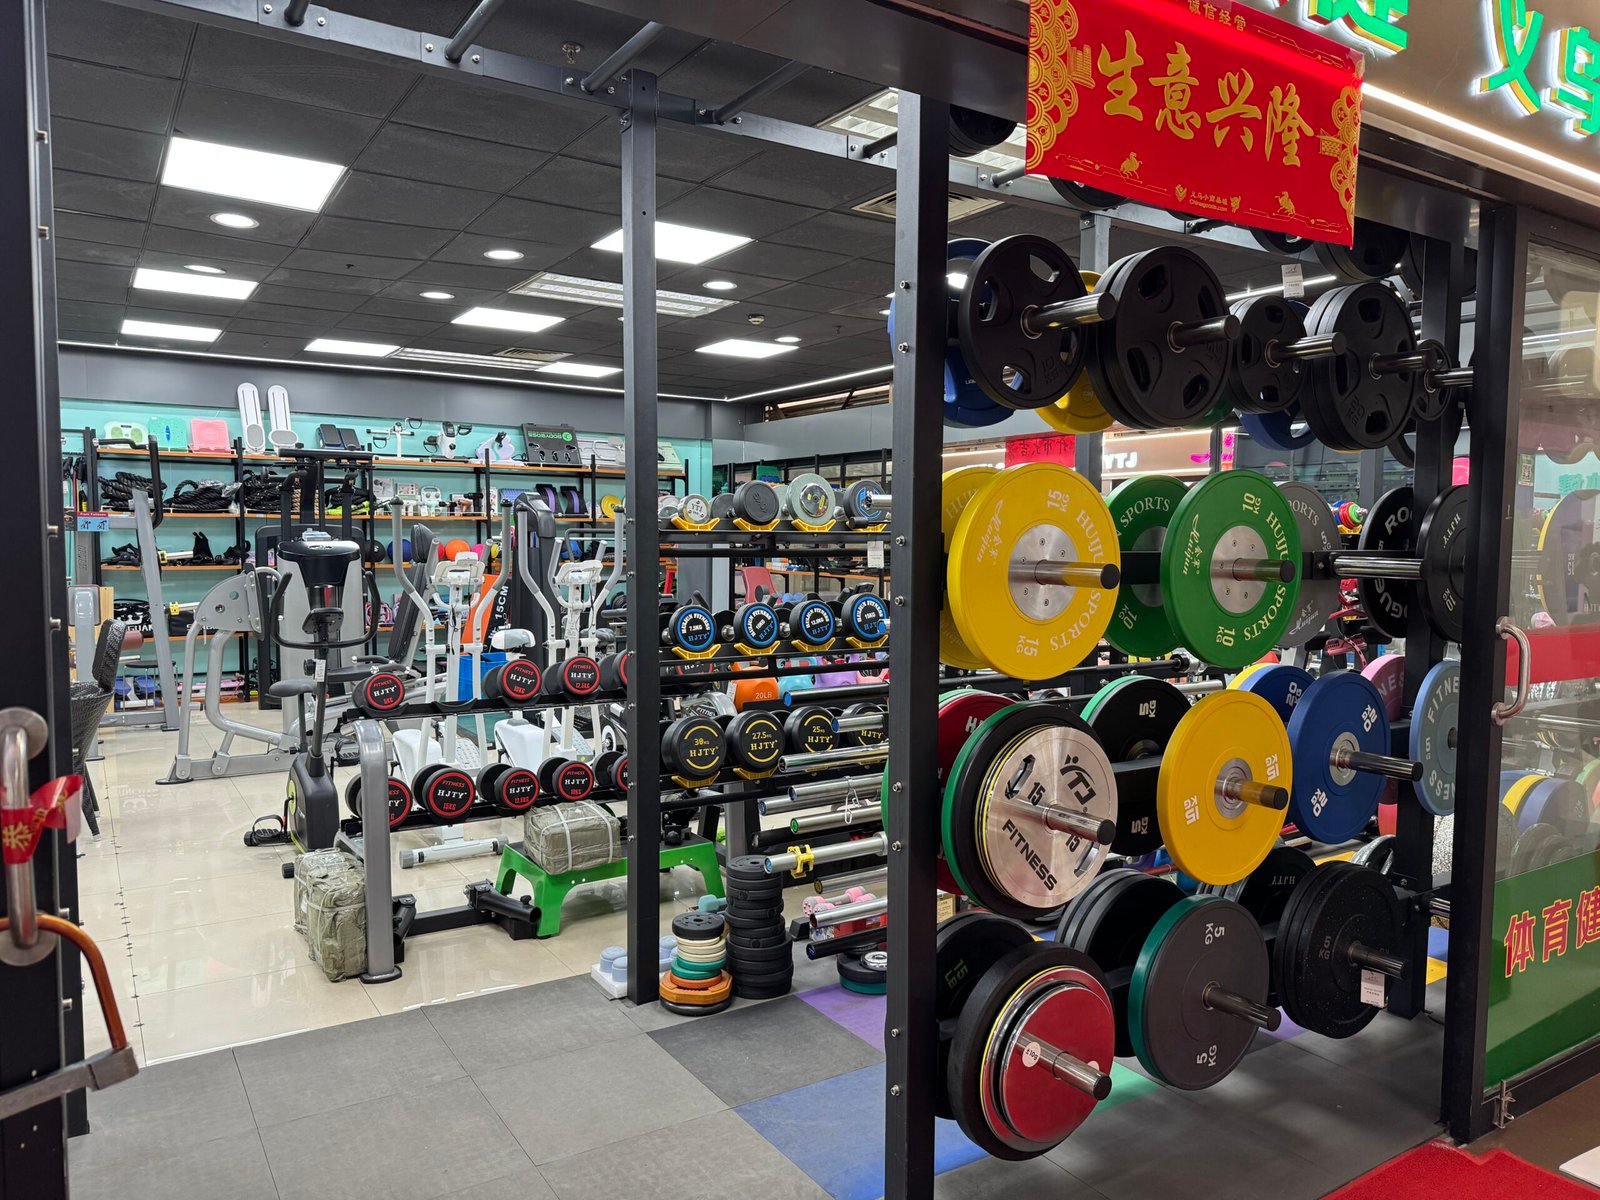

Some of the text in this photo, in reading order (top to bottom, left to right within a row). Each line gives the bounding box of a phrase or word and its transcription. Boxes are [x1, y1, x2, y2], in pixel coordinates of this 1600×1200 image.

[1097, 30, 1315, 168] 生意兴隆
[1047, 489, 1062, 508] 15
[1059, 494, 1070, 512] KG
[1242, 492, 1255, 512] 10
[1252, 497, 1262, 515] KG
[1120, 496, 1171, 528] SPORTS
[1287, 499, 1320, 527] ORTS
[495, 585, 509, 619] 15CM
[1050, 588, 1102, 651] SPORTS
[1118, 604, 1130, 620] KG
[1122, 610, 1139, 631] 10
[1243, 584, 1286, 641] SPORTS
[1216, 625, 1225, 643] KG
[1222, 628, 1236, 647] 10
[1016, 634, 1027, 654] KG
[1023, 638, 1040, 657] 15
[510, 673, 533, 685] HJTY
[373, 686, 396, 697] HJTY
[1427, 676, 1460, 724] FITNE
[1148, 700, 1157, 718] KG
[1361, 704, 1372, 720] KG
[1363, 707, 1378, 733] 20
[807, 735, 831, 743] HJTY
[861, 730, 882, 739] HJTY
[689, 747, 716, 758] HJTY
[750, 740, 776, 751] HJTY
[1265, 753, 1279, 767] KG
[1267, 764, 1280, 782] 15
[441, 780, 465, 788] FITNESS
[509, 786, 531, 794] HJTY
[437, 789, 465, 799] HJTY
[1027, 781, 1046, 807] 15
[1183, 795, 1198, 809] KG
[1311, 788, 1322, 805] KG
[1312, 792, 1329, 818] 20
[1140, 816, 1149, 835] KG
[1185, 807, 1200, 826] 15
[1002, 819, 1058, 892] FITNESS
[1204, 922, 1214, 945] KG
[1214, 926, 1225, 938] 5
[1323, 935, 1332, 949] 5
[1318, 948, 1330, 960] KG
[1196, 1052, 1208, 1065] 5
[1207, 1044, 1217, 1067] KG
